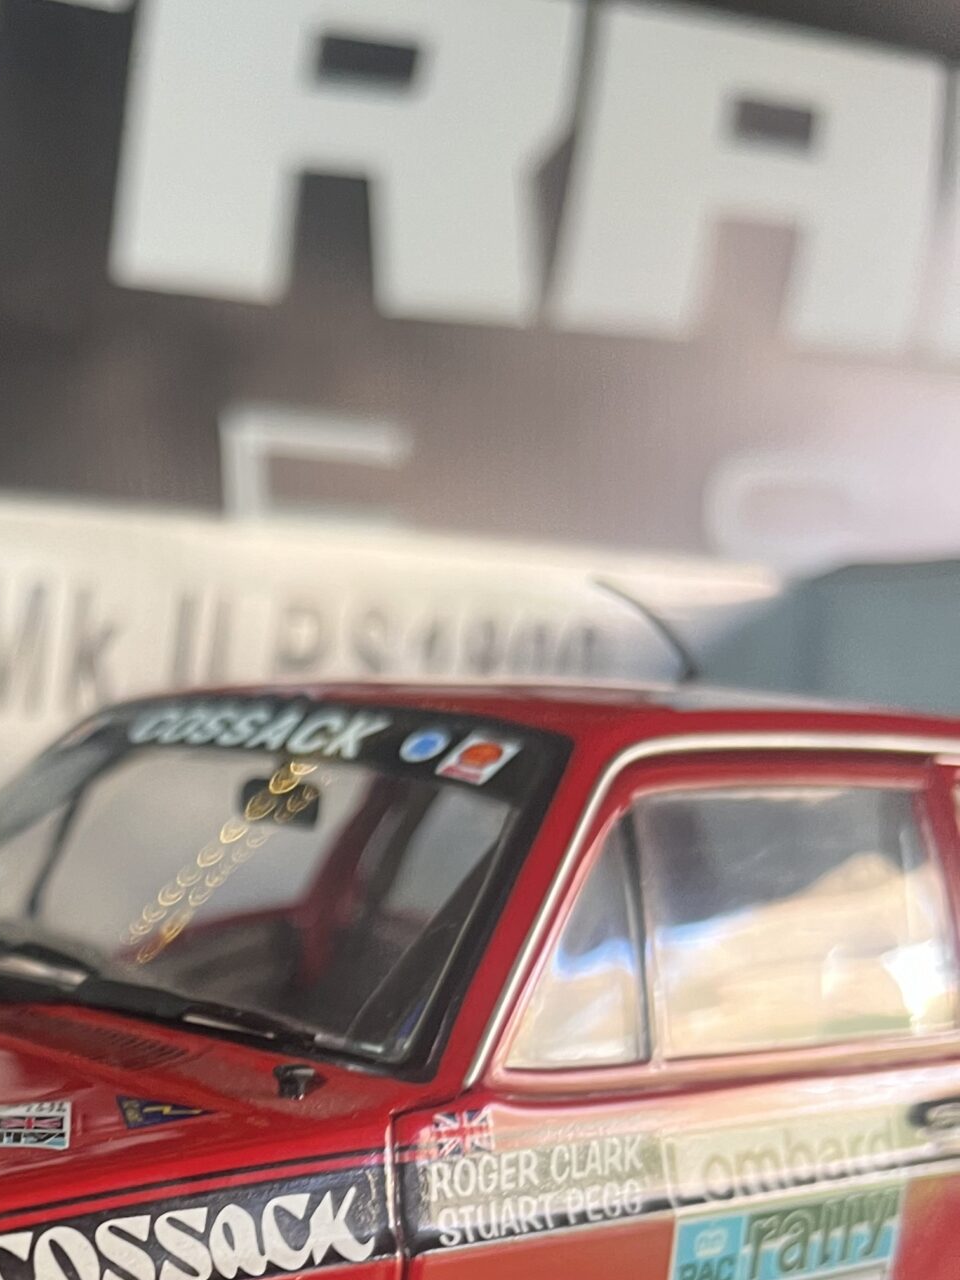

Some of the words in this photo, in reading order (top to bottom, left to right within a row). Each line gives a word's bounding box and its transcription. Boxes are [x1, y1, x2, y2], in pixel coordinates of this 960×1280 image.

[128, 706, 393, 760] COSSACK
[430, 1149, 540, 1201] ROGER
[549, 1134, 644, 1185] CLARK
[665, 1105, 902, 1204] Lombard
[439, 1192, 556, 1247] STUART
[566, 1178, 643, 1226] PEGG
[748, 1187, 900, 1280] rally
